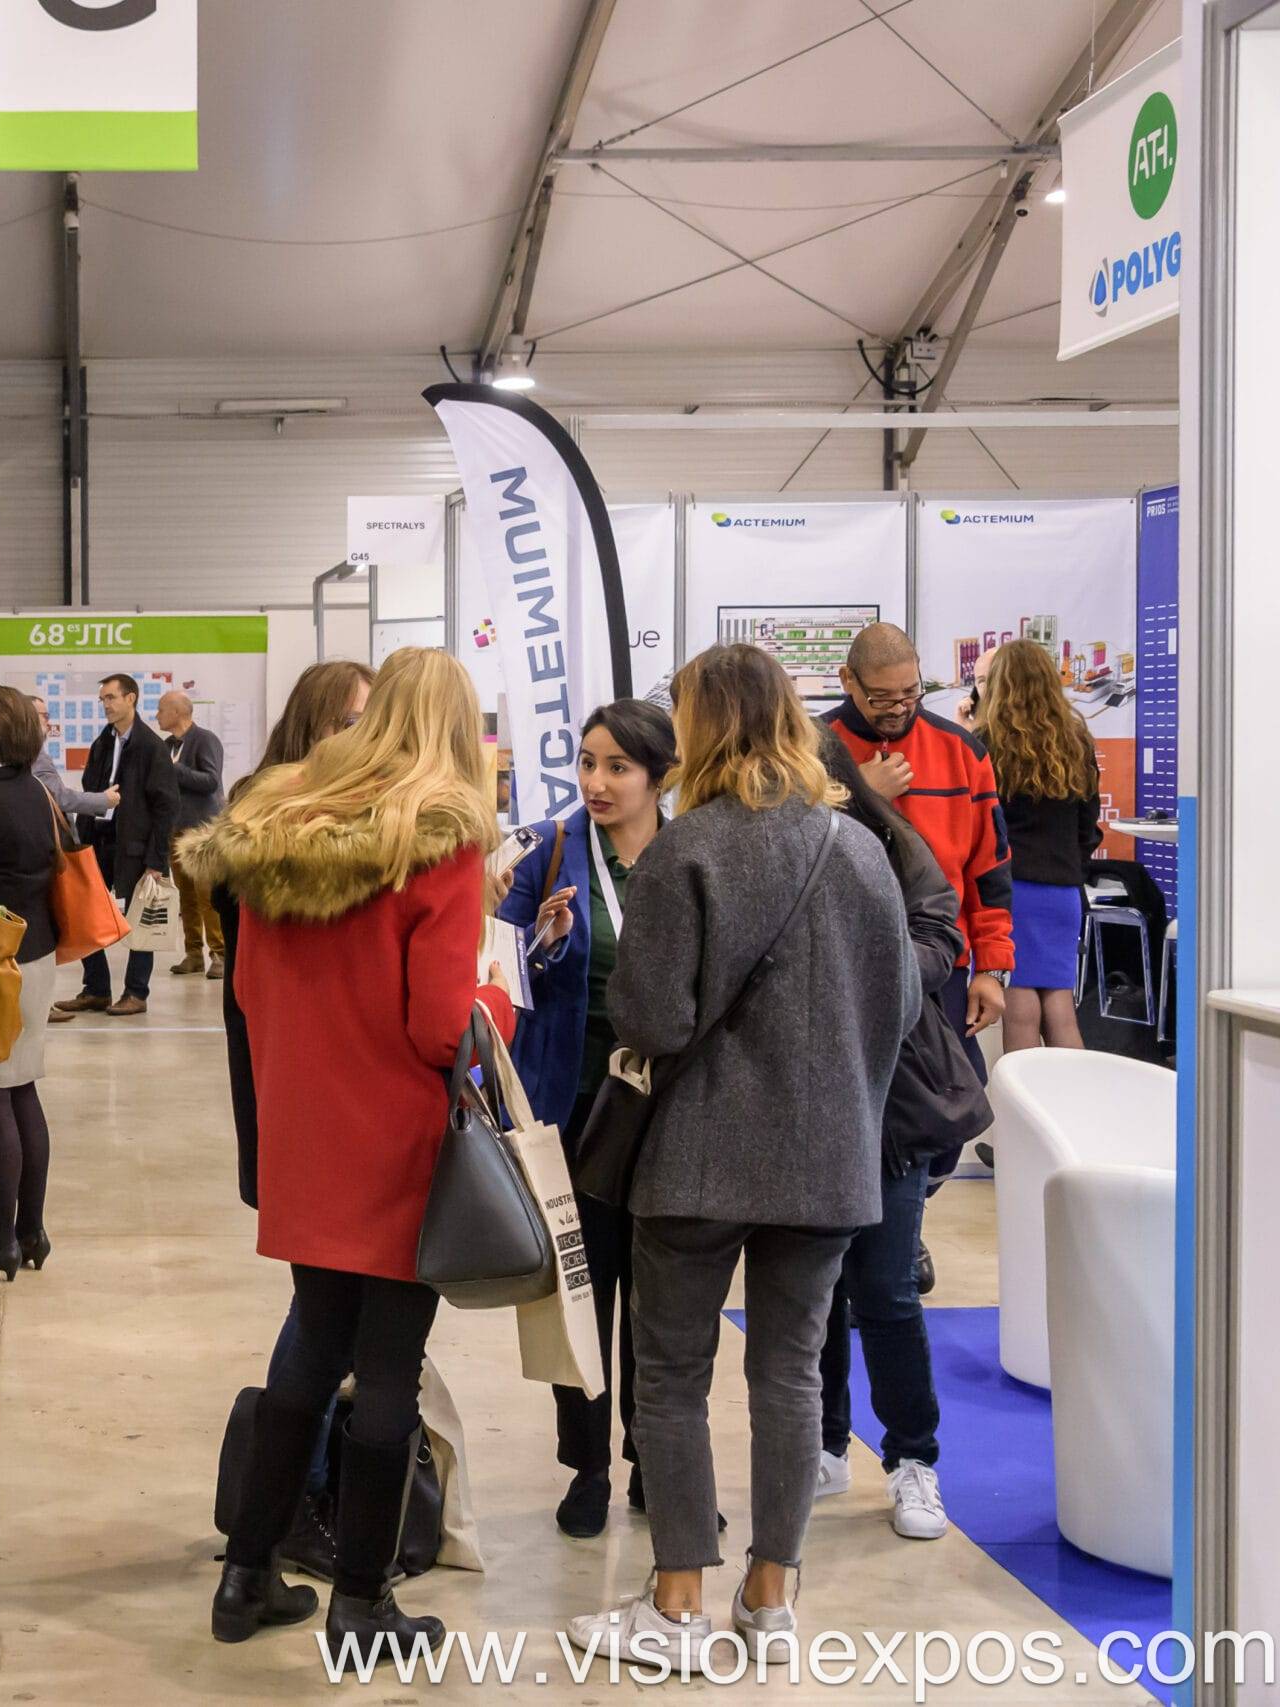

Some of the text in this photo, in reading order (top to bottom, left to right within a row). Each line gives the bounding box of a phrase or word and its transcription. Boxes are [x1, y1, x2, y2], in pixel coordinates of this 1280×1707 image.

[1111, 231, 1182, 304] POLYG
[733, 518, 806, 528] ACTEMIUM
[962, 514, 1035, 524] ACTEMIUM
[366, 521, 426, 530] SPECTRALYS
[350, 552, 370, 561] G45
